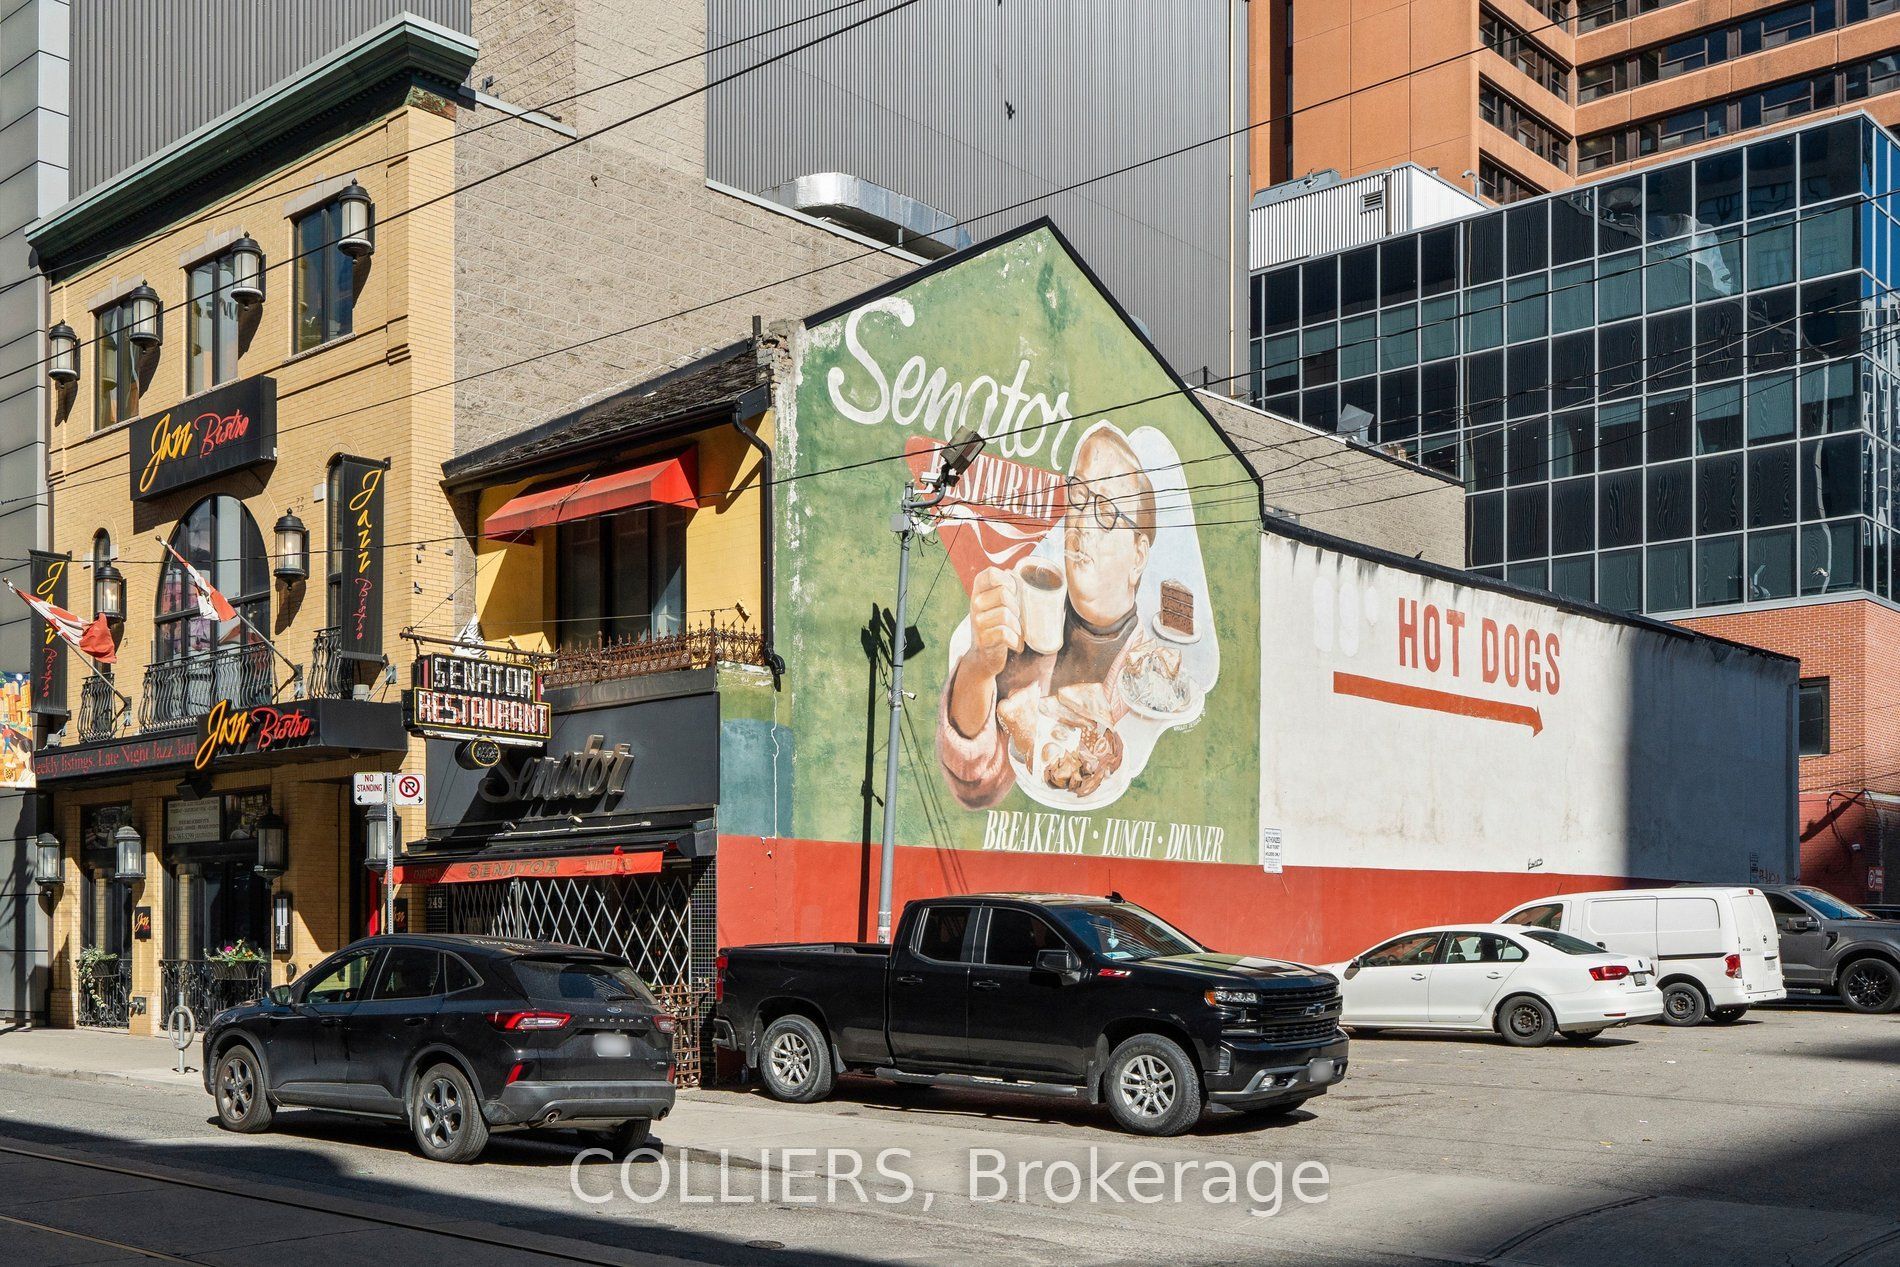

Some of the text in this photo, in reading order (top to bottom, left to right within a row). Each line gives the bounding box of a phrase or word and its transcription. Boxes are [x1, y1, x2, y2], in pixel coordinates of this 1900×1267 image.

[827, 296, 1073, 470] Senator
[139, 408, 250, 493] Jazz Bistro
[929, 441, 1061, 522] RSTAURANT
[349, 468, 382, 574] Jazz
[354, 577, 373, 641] Bistro
[1398, 596, 1561, 695] HOT DOGS
[433, 656, 533, 699] SENATOR
[194, 699, 311, 770] Jazz Bistro
[417, 690, 549, 734] RESTAURANT
[35, 757, 58, 777] eekly
[121, 744, 150, 767] Night
[153, 740, 174, 760] Jazz
[364, 774, 374, 782] NO
[356, 783, 383, 793] STANDING
[982, 810, 1225, 863] BREAKFAST LUNCH DINNER
[467, 859, 560, 879] SENATOR
[427, 896, 443, 909] 249
